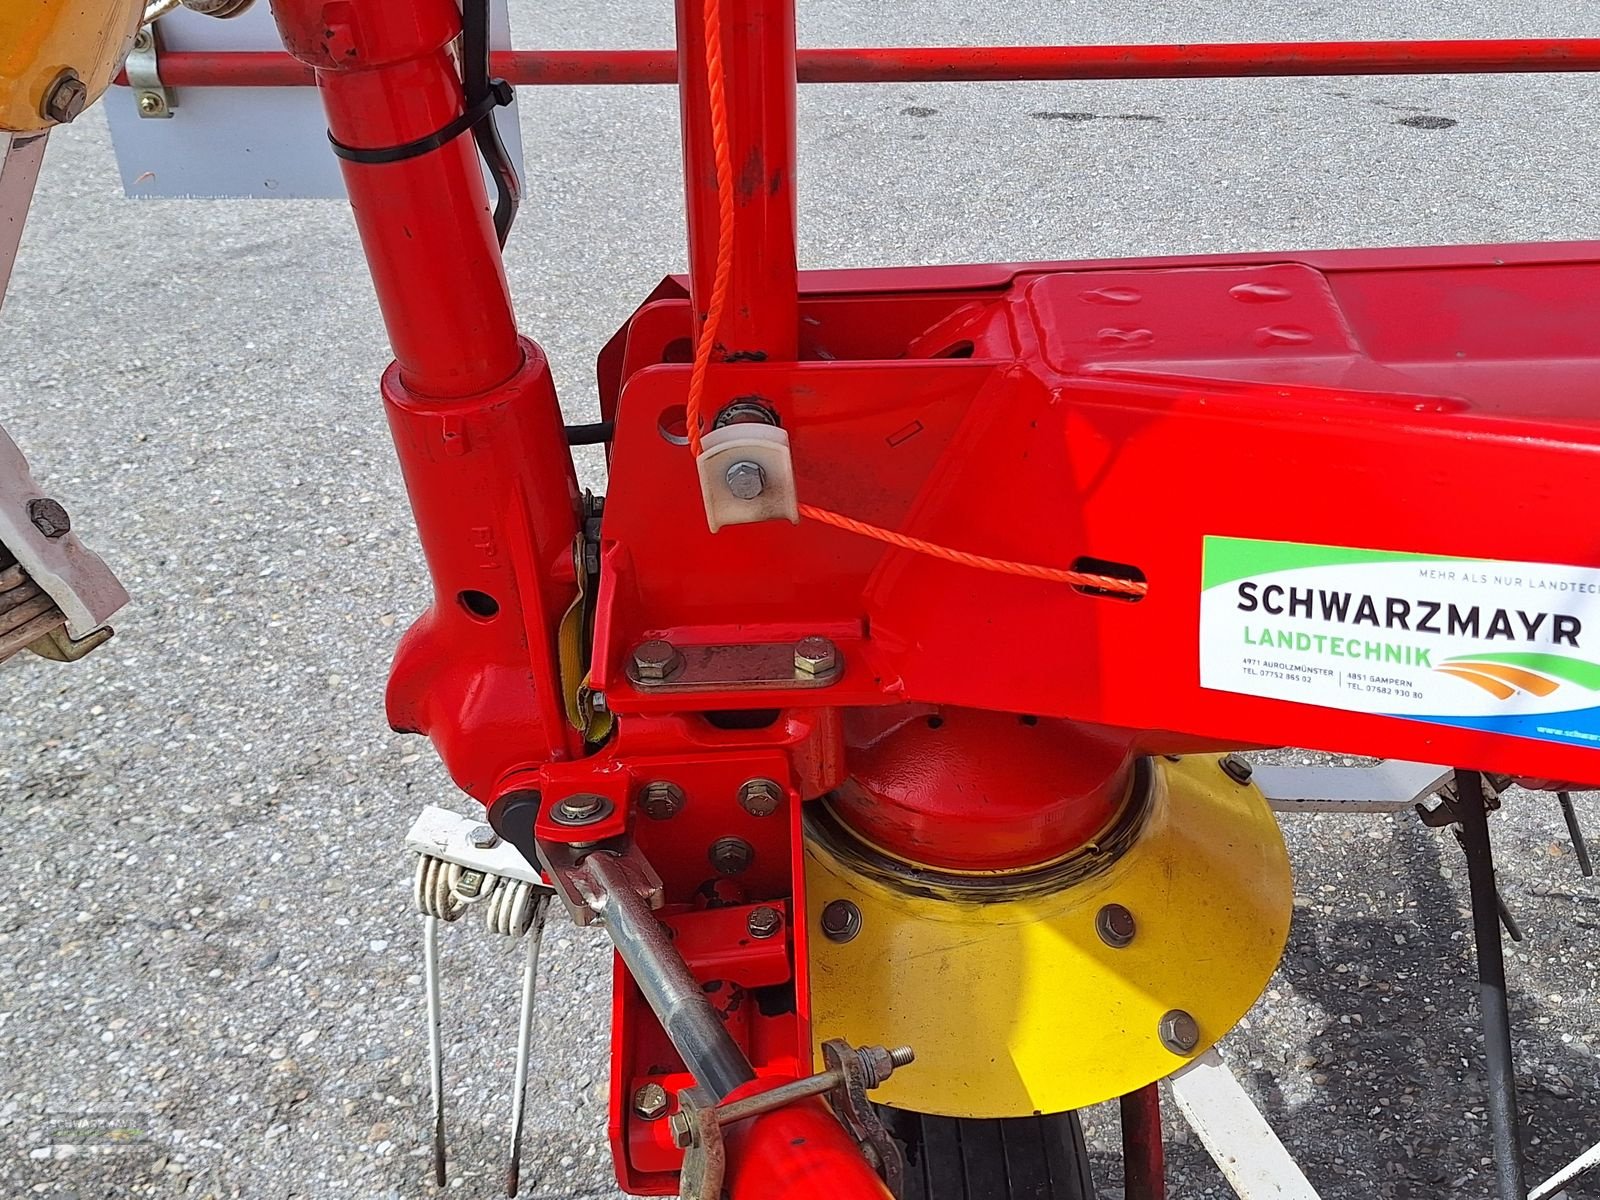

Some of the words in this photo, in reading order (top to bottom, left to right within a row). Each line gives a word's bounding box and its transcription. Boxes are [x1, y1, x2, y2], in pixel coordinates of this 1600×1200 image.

[1418, 569, 1455, 581] MEHR
[1462, 573, 1487, 584] ALS
[1495, 575, 1522, 587] NUR
[1237, 581, 1582, 648] SCHWARZMAYR
[1243, 626, 1433, 669] LANDTECHNIK
[1242, 657, 1261, 667] 4971
[1263, 659, 1334, 677] AUROLZMÜNSTER
[1242, 667, 1258, 676] TEL.
[1260, 669, 1284, 680] 07752
[1301, 675, 1312, 684] 02
[1346, 671, 1367, 682] 4851
[1369, 675, 1413, 688] GAMPERN
[1347, 681, 1363, 691] TEL.
[1394, 688, 1410, 698] 930
